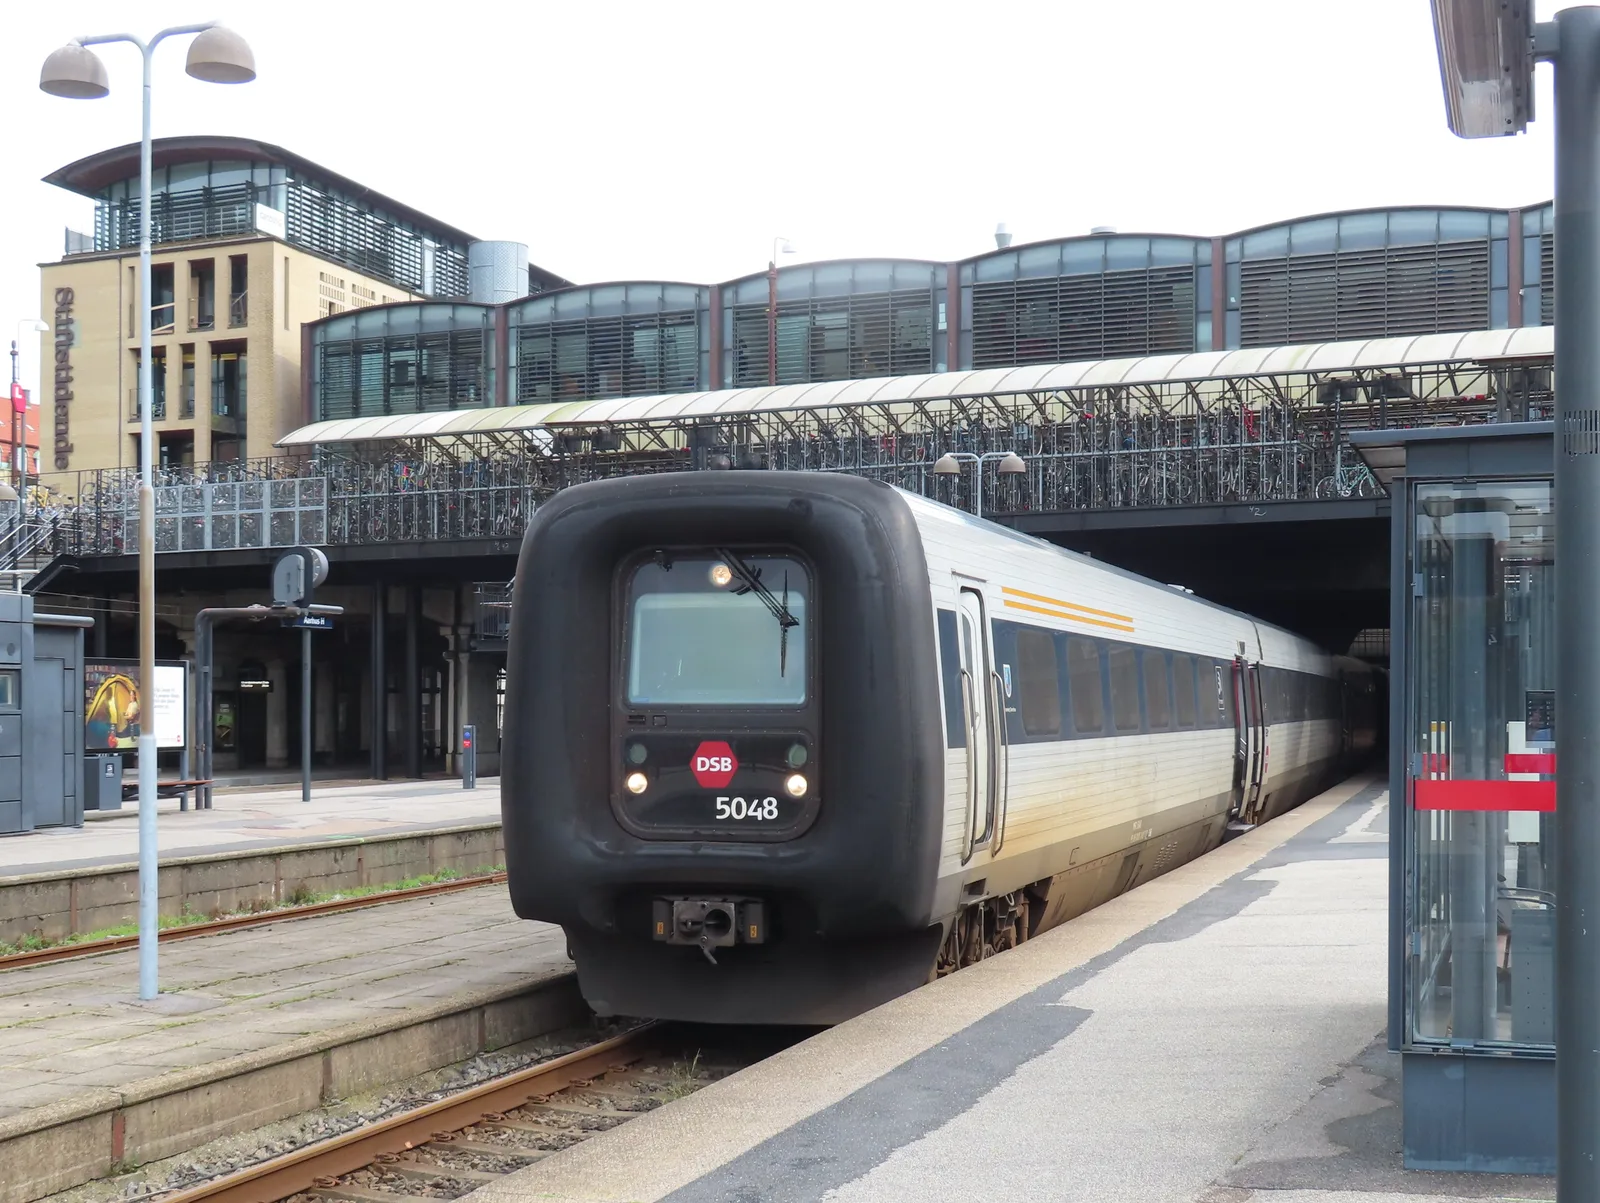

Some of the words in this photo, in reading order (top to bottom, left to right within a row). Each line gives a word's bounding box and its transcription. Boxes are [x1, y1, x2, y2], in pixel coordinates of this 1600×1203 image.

[55, 287, 74, 470] Stiftstidende
[15, 386, 23, 399] L
[303, 616, 320, 625] Aarhus
[320, 617, 325, 625] H
[696, 757, 732, 772] DSB
[715, 796, 779, 821] 5048
